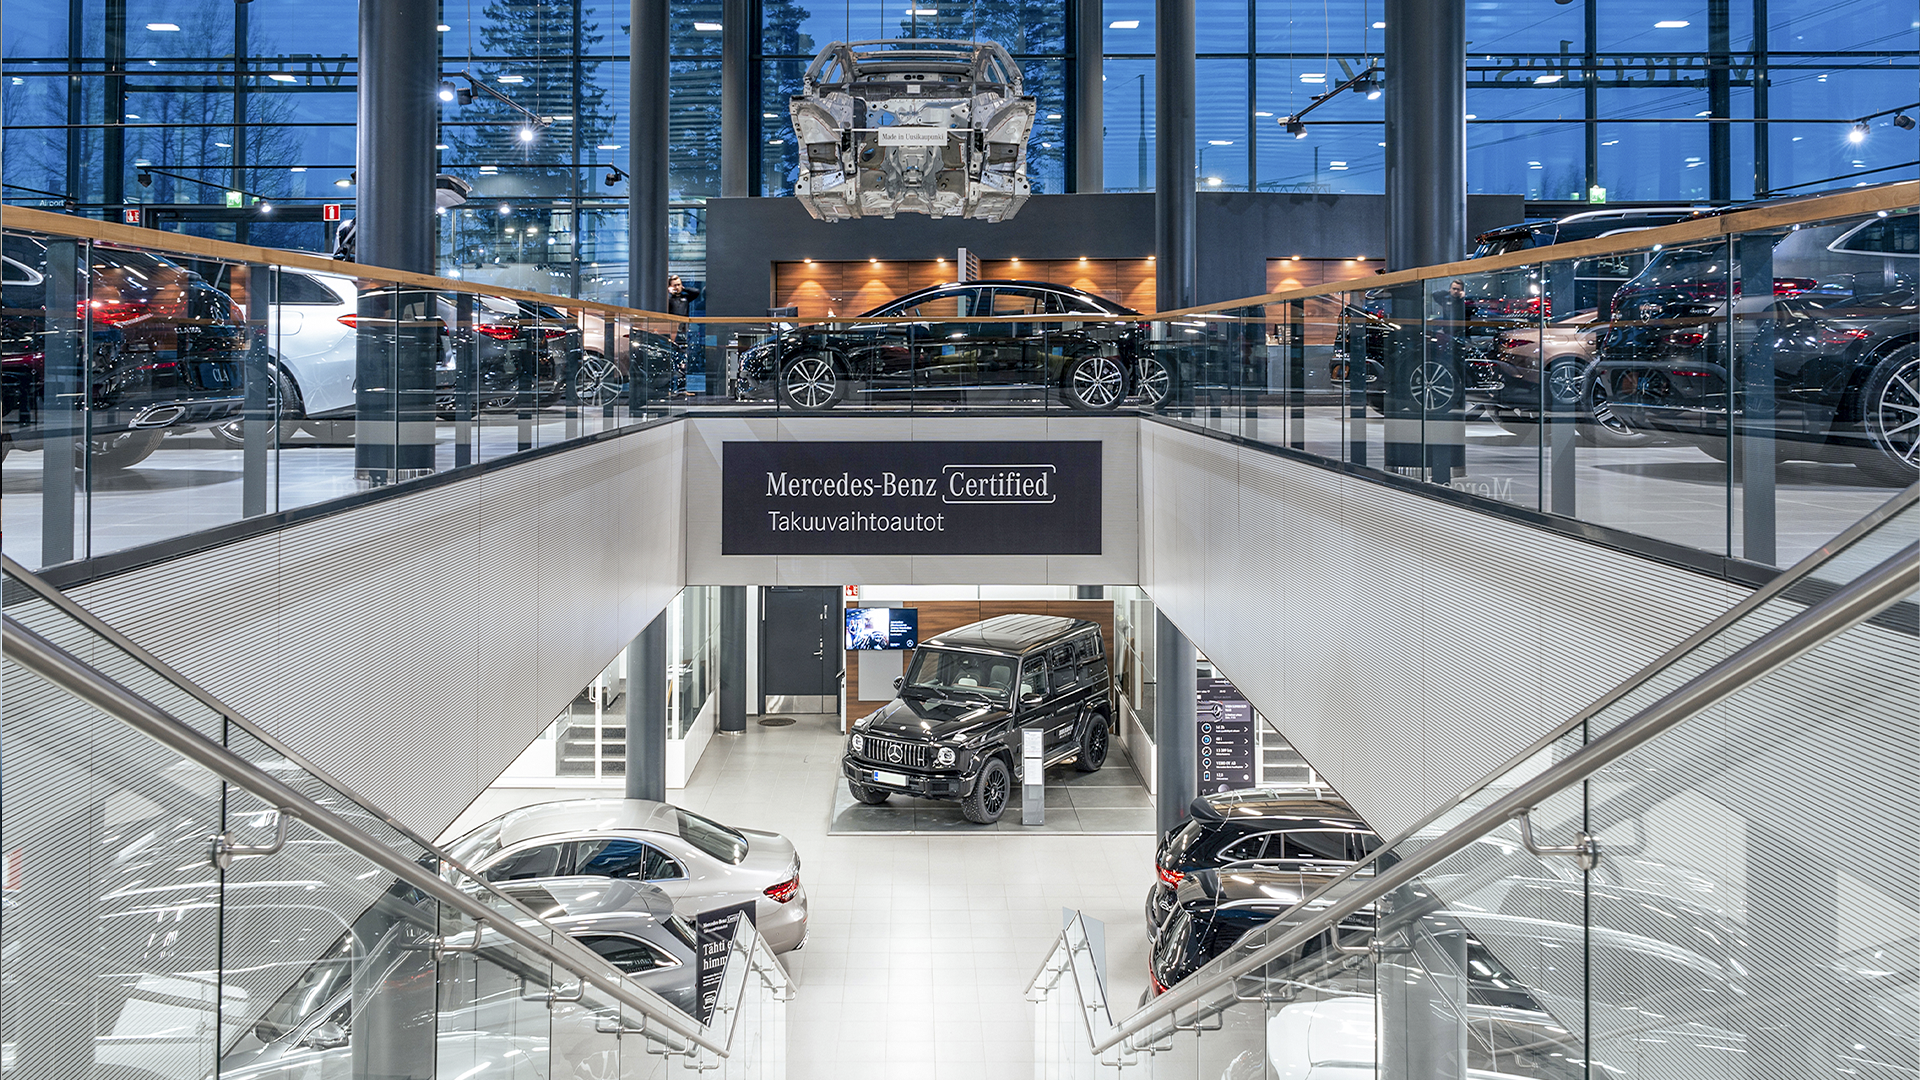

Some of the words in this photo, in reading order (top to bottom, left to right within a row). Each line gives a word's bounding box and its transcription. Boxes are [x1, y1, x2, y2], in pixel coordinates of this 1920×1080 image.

[905, 133, 944, 142] Uusikaupunki
[212, 368, 230, 382] CLA
[766, 472, 937, 497] Mercedes-Benz
[949, 472, 1049, 497] Certified
[767, 511, 945, 532] Takuuvaihtoautot
[702, 939, 726, 956] Tähti
[702, 956, 728, 971] himm
